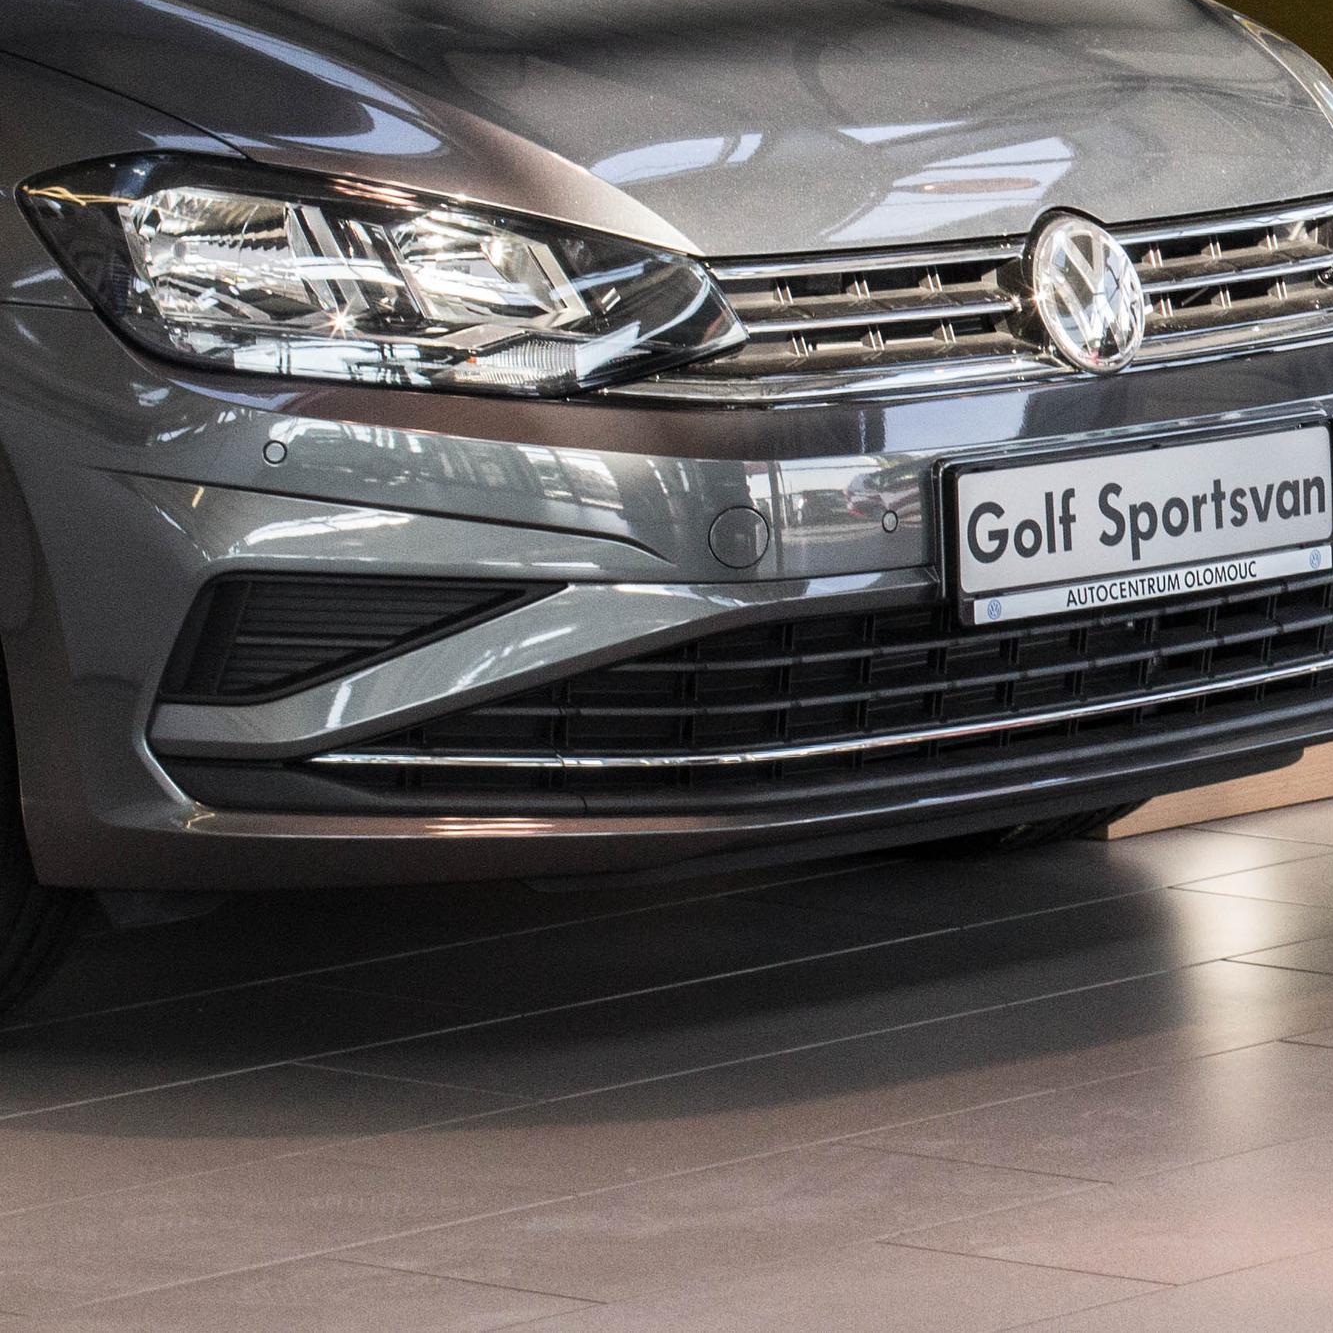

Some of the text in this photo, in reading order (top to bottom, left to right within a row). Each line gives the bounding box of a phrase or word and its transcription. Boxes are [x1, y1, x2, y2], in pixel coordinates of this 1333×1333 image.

[966, 474, 1326, 564] Golf Sportsvan
[1066, 560, 1258, 608] AUTOCENTRUM OLOMOUC
